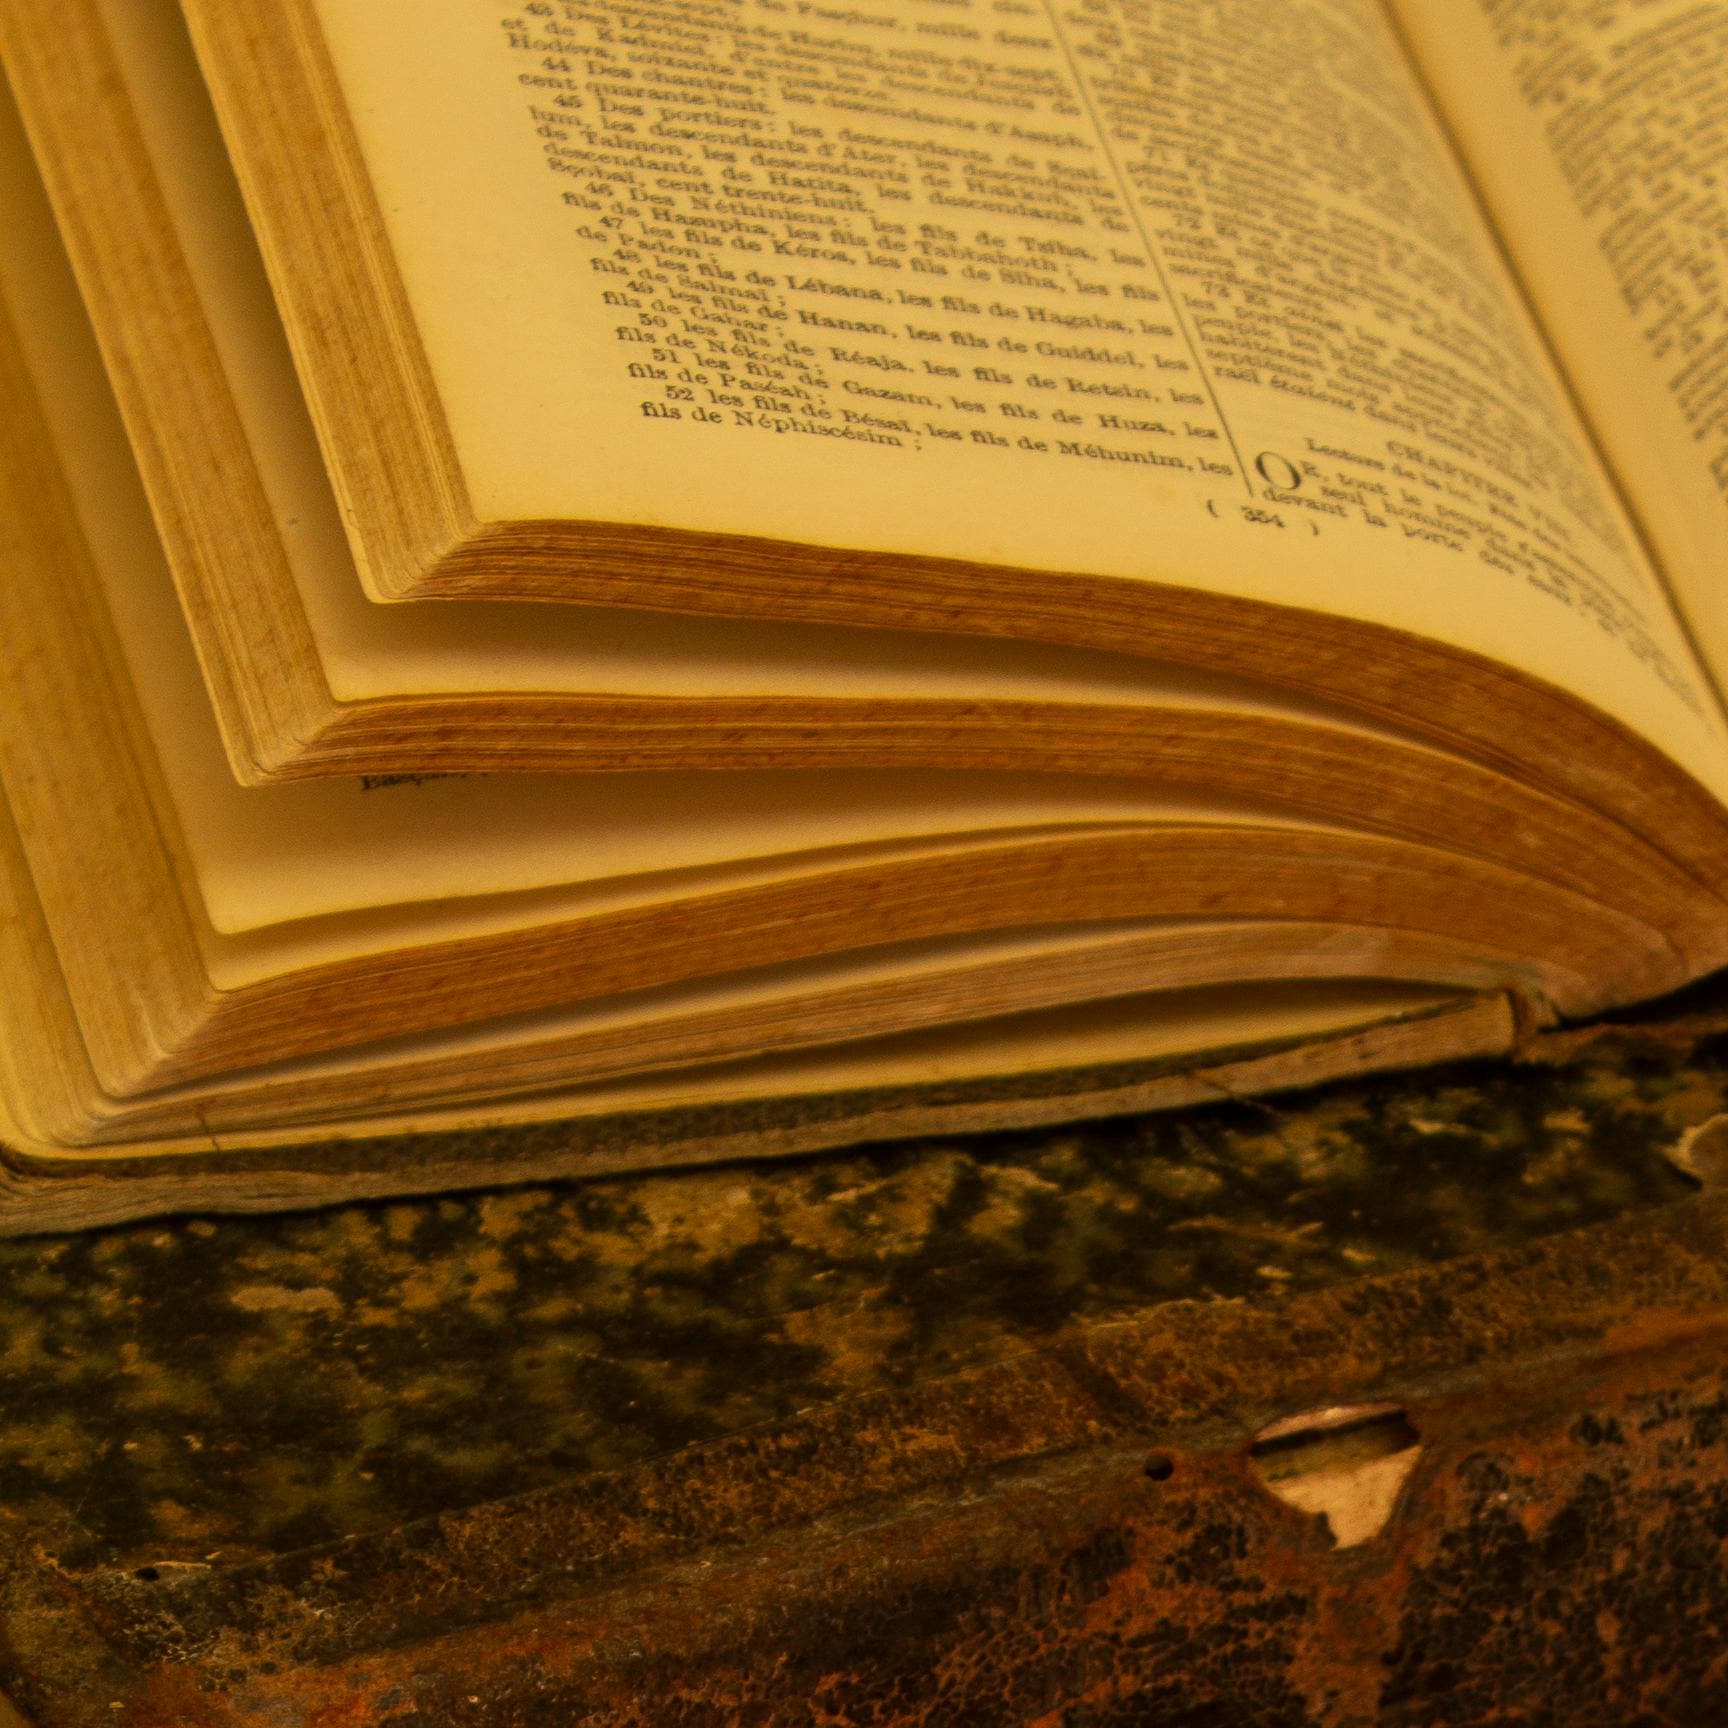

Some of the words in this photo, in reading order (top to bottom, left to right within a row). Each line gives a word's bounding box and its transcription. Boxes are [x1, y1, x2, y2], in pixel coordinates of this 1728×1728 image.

[657, 179, 713, 194] cent
[722, 167, 751, 182] de
[562, 193, 601, 210] fils
[611, 202, 640, 217] de
[787, 225, 820, 241] les
[831, 230, 868, 247] fils
[878, 236, 905, 251] de
[576, 227, 606, 242] de
[630, 188, 674, 206] Des
[976, 232, 1004, 247] de
[590, 258, 628, 275] fils
[638, 269, 668, 283] de
[601, 217, 622, 227] 47
[641, 222, 674, 239] les
[685, 230, 722, 246] fils
[732, 237, 761, 251] de
[867, 252, 901, 269] les
[911, 258, 947, 275] fils
[962, 266, 990, 281] de
[1075, 279, 1109, 296] les
[1122, 285, 1158, 300] fils
[603, 291, 640, 307] fils
[651, 300, 680, 314] de
[655, 256, 688, 272] les
[698, 264, 735, 281] fils
[746, 272, 775, 286] de
[899, 291, 932, 307] les
[941, 297, 980, 313] fils
[989, 303, 1018, 318] de
[1140, 320, 1173, 336] les
[616, 327, 655, 342] fils
[666, 334, 695, 348] de
[669, 288, 702, 304] les
[712, 296, 748, 313] fils
[758, 305, 787, 320] de
[799, 311, 896, 337] Hanan,
[907, 326, 941, 341] les
[950, 332, 988, 348] fils
[998, 338, 1027, 353] de
[1155, 355, 1188, 370] les
[628, 363, 667, 379] fils
[678, 369, 708, 384] de
[639, 313, 666, 327] 50
[683, 320, 717, 336] les
[732, 329, 770, 347] fils
[785, 341, 814, 356] de
[924, 361, 959, 377] les
[974, 368, 1012, 384] fils
[1027, 375, 1055, 389] de
[1171, 390, 1203, 404] les
[641, 402, 680, 419] fils
[692, 408, 721, 423] de
[653, 348, 677, 363] 51
[696, 354, 730, 370] les
[746, 362, 783, 379] fils
[799, 374, 828, 388] de
[843, 381, 941, 408] Gazam,
[951, 397, 985, 412] les
[1000, 404, 1038, 419] fils
[1052, 410, 1081, 424] de
[1186, 424, 1218, 439] les
[666, 386, 693, 401] 52
[709, 390, 743, 406] les
[754, 396, 791, 413] fils
[801, 404, 831, 419] de
[927, 424, 962, 440] les
[971, 431, 1008, 446] fils
[1018, 437, 1047, 451] de
[1199, 458, 1233, 476] les
